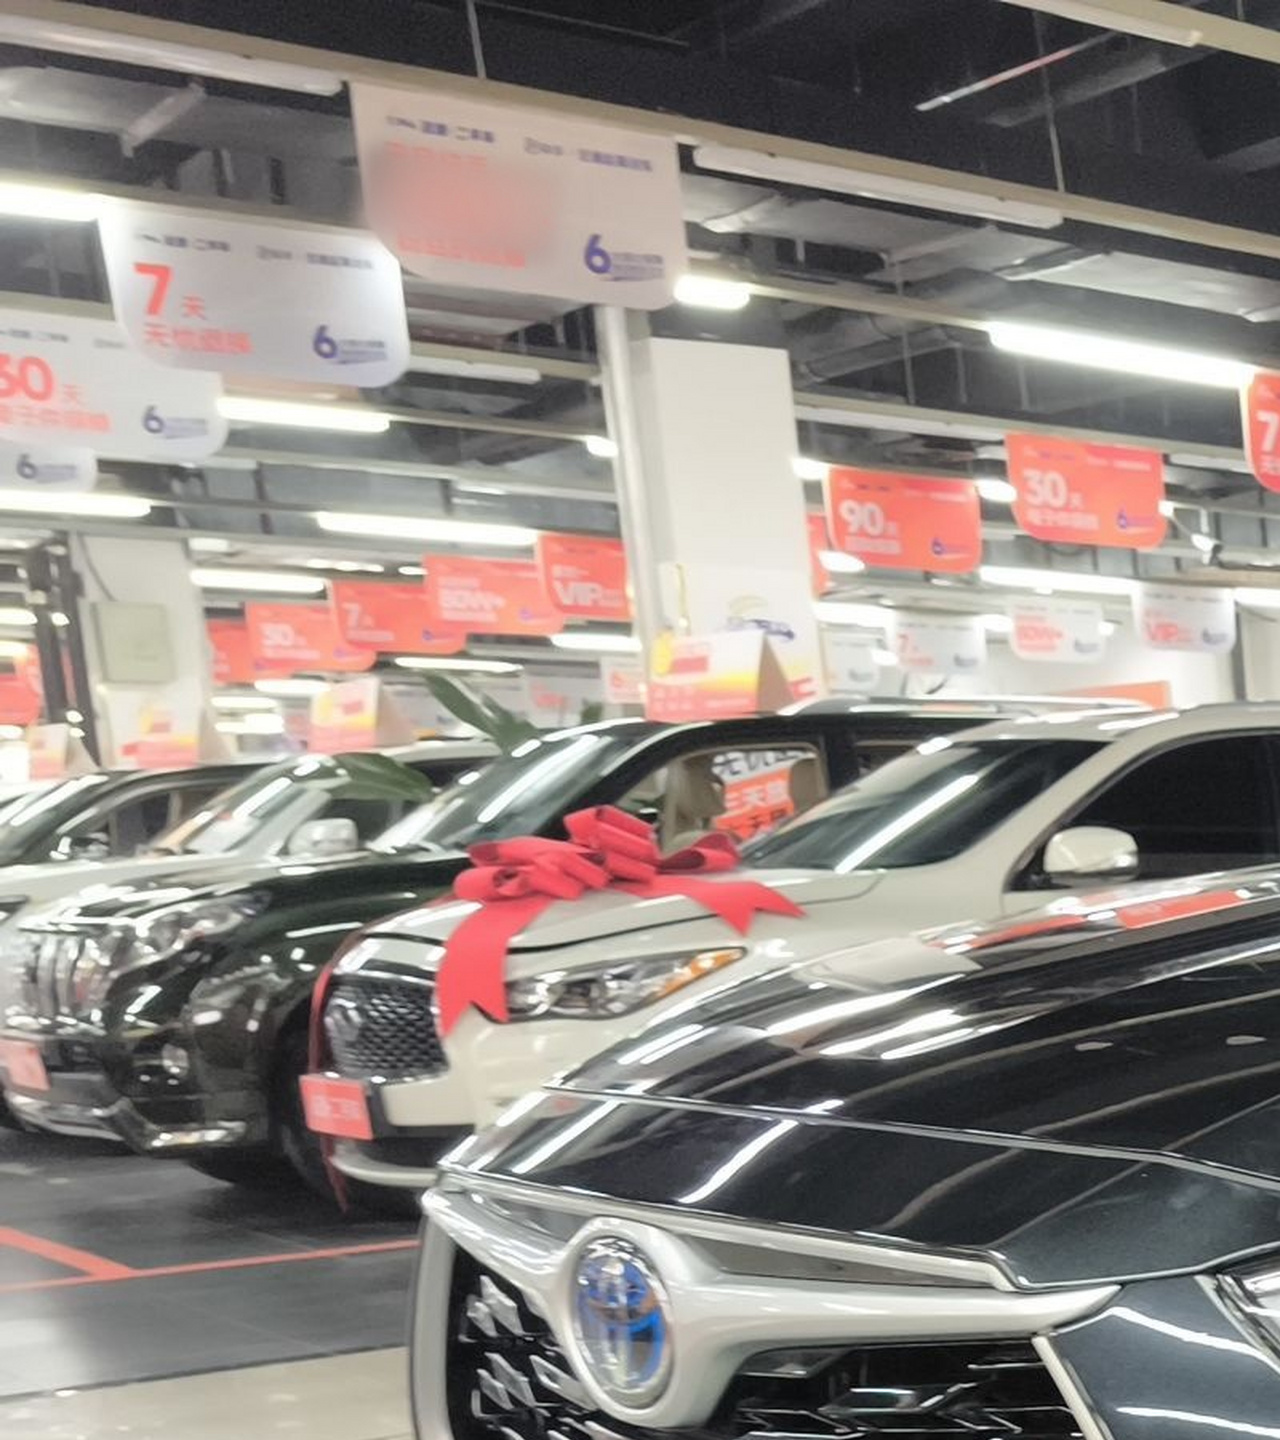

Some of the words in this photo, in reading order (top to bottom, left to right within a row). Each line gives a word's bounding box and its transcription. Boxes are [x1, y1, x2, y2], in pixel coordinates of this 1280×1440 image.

[584, 234, 612, 274] 6
[133, 262, 172, 316] 7
[313, 324, 337, 359] 6
[142, 404, 164, 434] 6
[1257, 411, 1280, 453] 7
[16, 453, 38, 480] 6
[1022, 468, 1068, 508] 30
[838, 499, 886, 537] 90
